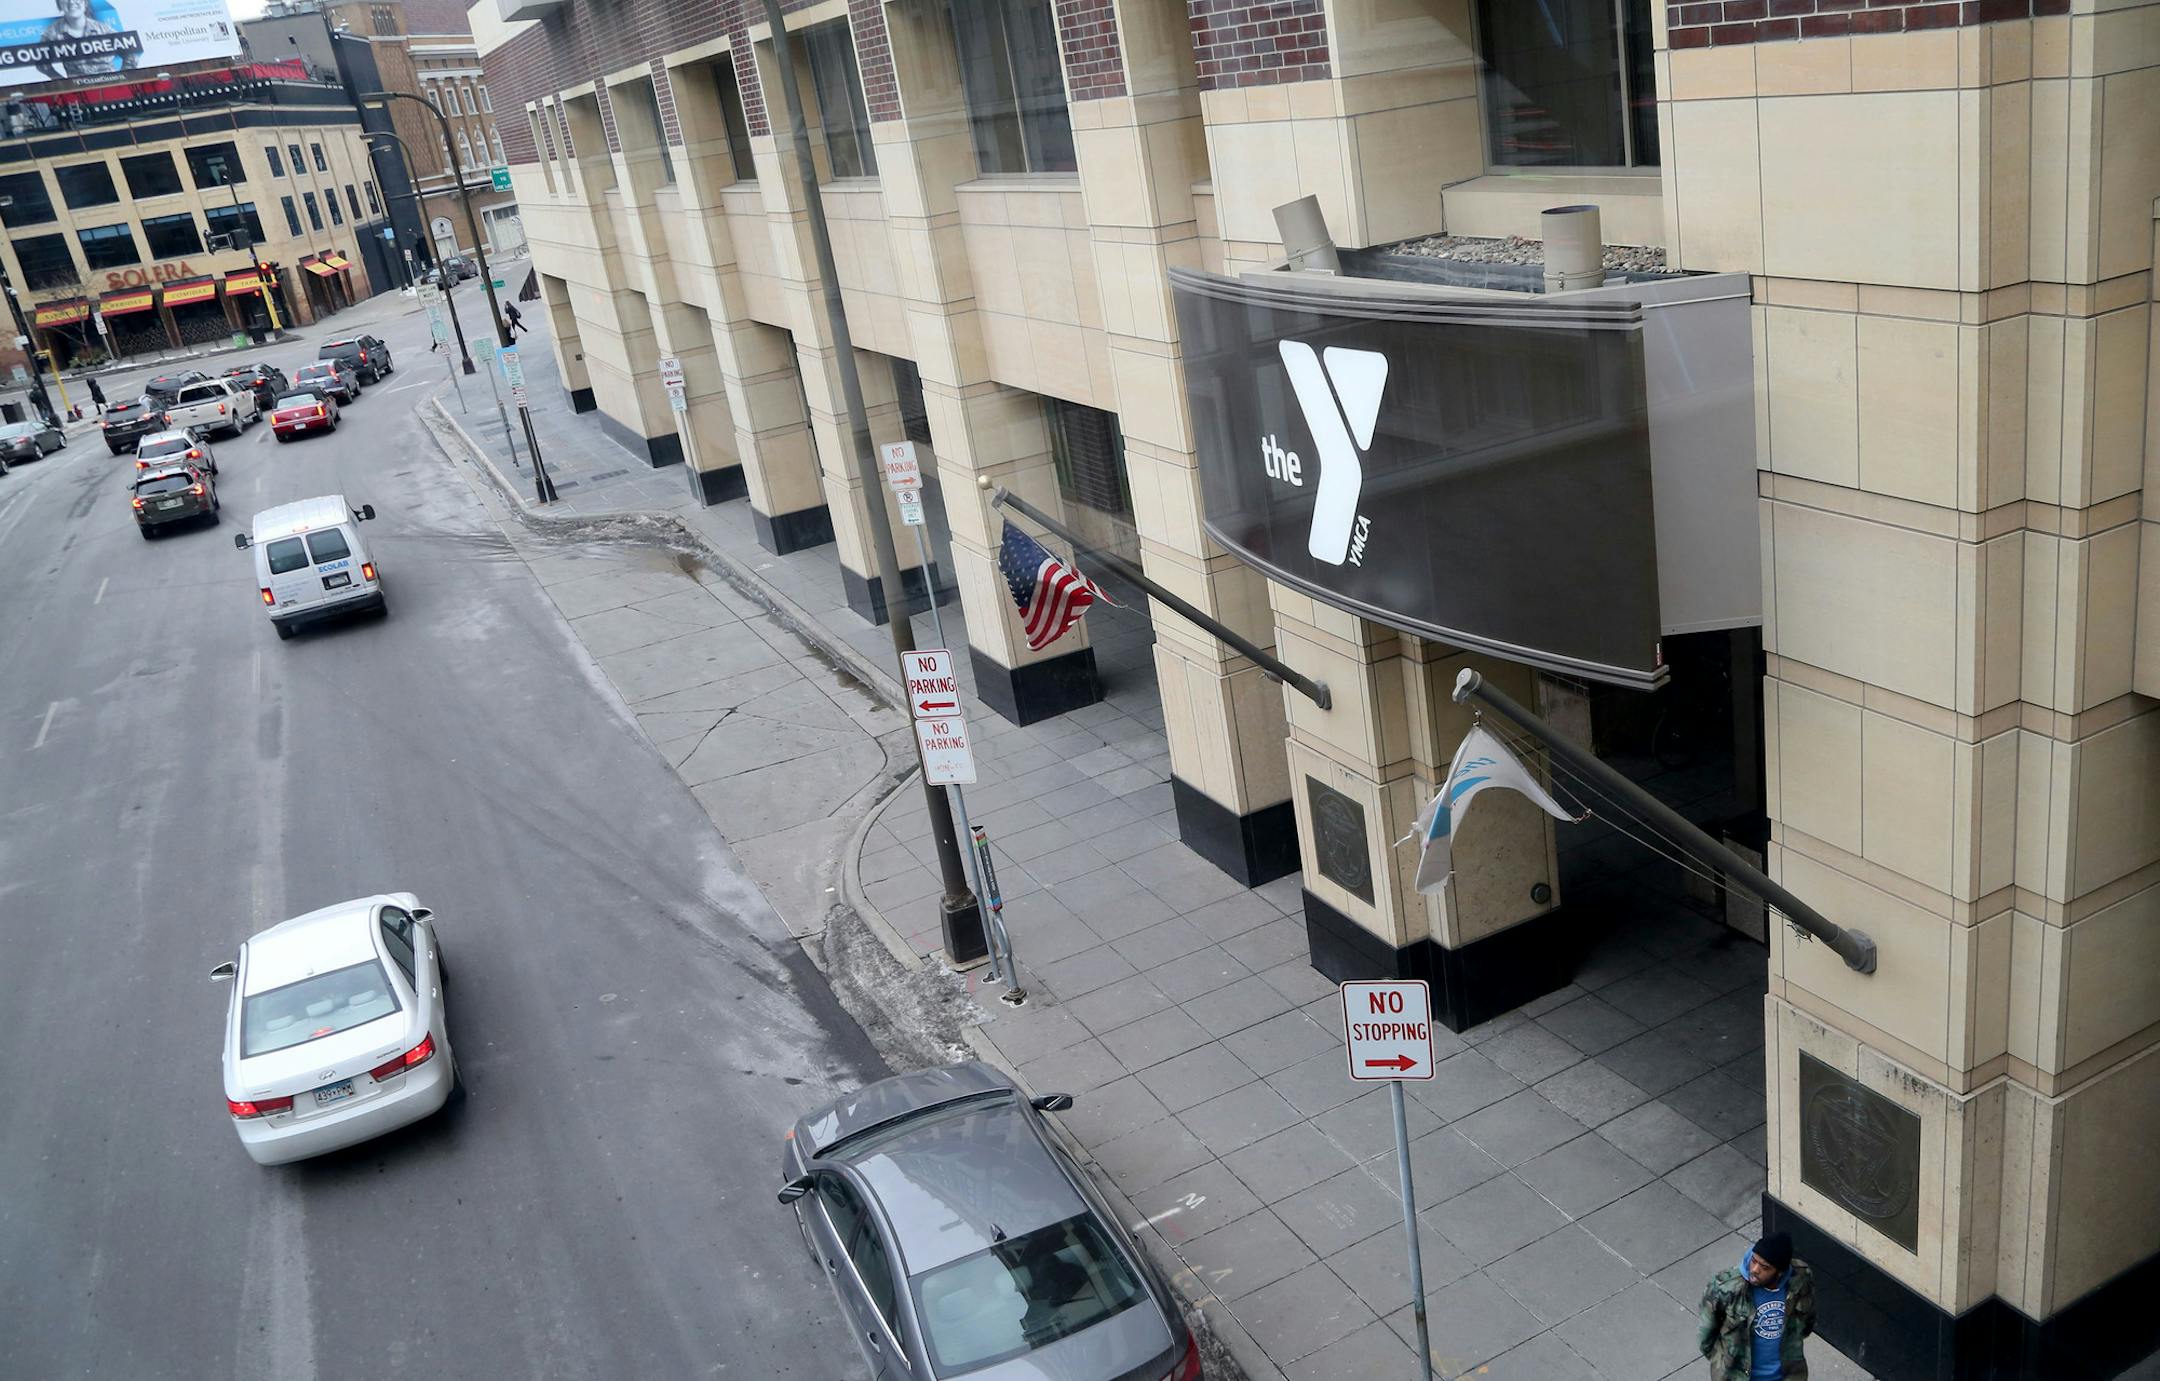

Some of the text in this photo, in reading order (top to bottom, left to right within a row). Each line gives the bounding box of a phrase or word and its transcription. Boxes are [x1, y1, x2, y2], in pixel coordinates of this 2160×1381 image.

[145, 25, 208, 41] Metropolitan
[0, 35, 137, 65] G OUT MY DREAM
[106, 260, 197, 290] SOLERA
[664, 360, 674, 369] NO
[892, 446, 905, 459] NO
[1261, 339, 1389, 566] the Y
[887, 460, 916, 474] PARKING
[1349, 515, 1371, 567] YMCA
[318, 560, 349, 573] ECOLAB
[917, 656, 937, 673] NO
[910, 676, 956, 695] PARKING
[932, 722, 949, 735] NO
[925, 736, 965, 751] PARKING
[1368, 990, 1404, 1015] NO
[1352, 1022, 1427, 1042] STOPPING
